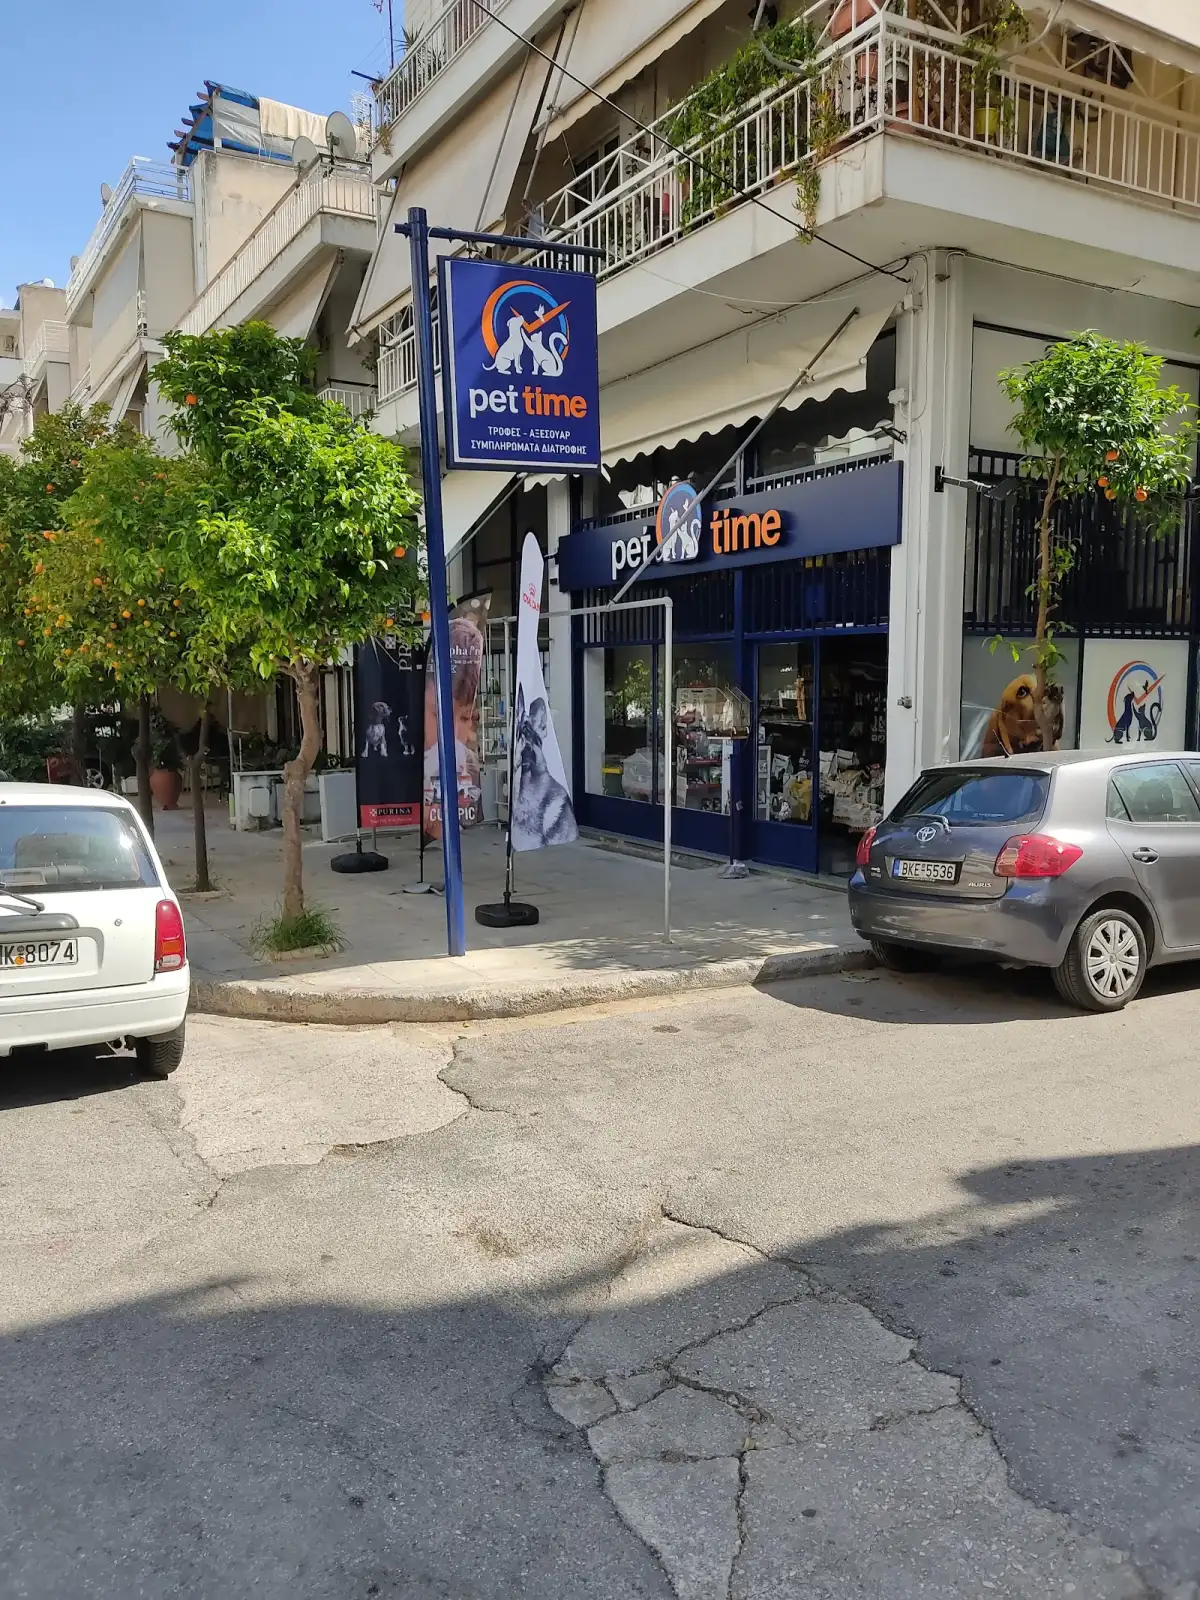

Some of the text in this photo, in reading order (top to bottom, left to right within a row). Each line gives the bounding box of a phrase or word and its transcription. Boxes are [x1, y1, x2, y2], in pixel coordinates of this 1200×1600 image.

[469, 384, 587, 419] pet time
[487, 425, 521, 438] ΤΡΟΦΕΣ
[529, 428, 571, 440] ΑΞΕΣΟΥΑΡ
[471, 439, 587, 455] ΣΥΜΠΛΗΡΩΜΑΤΑ ΔΙΑΤΡΟΦΗΣ
[612, 508, 782, 581] pet time
[378, 808, 411, 816] PURINA
[429, 807, 476, 822] CUPIC
